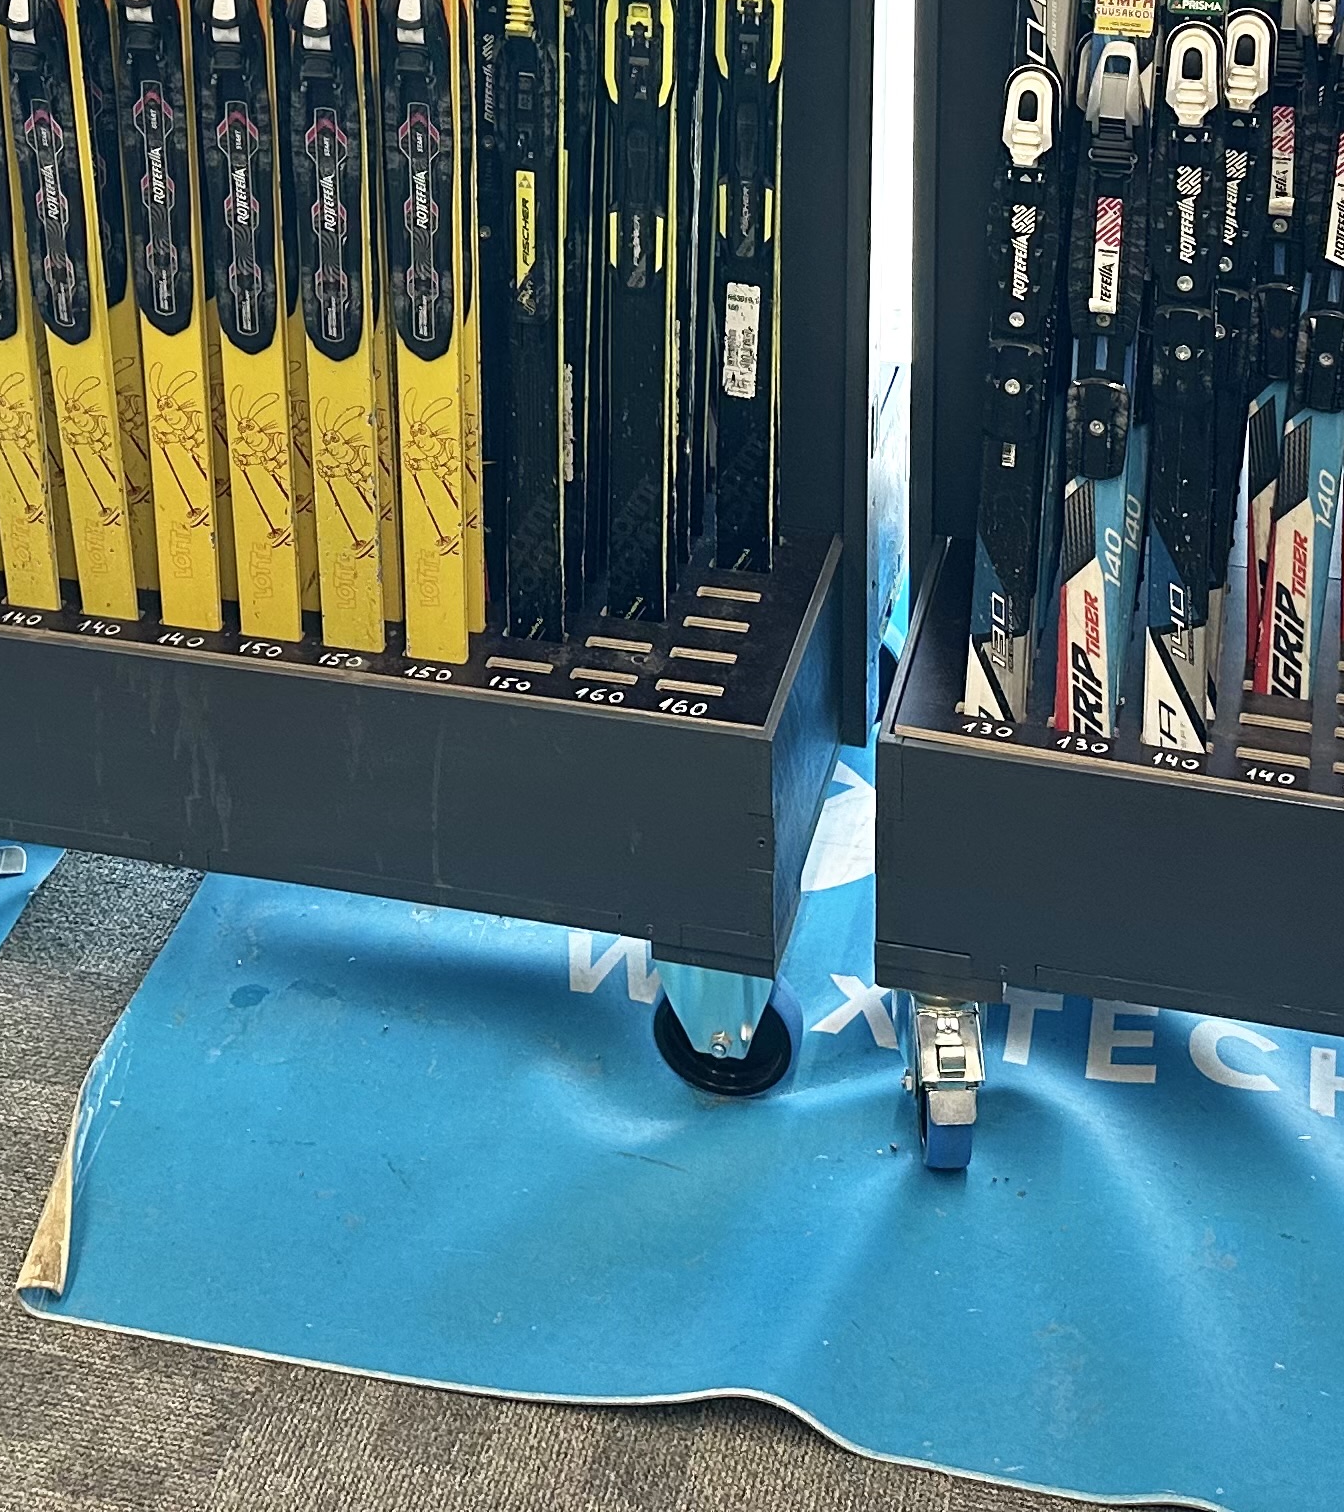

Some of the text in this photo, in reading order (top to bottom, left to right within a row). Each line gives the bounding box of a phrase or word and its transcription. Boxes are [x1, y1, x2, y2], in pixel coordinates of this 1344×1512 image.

[520, 196, 532, 268] FISCHER
[1, 610, 42, 627] 140
[77, 619, 121, 637] 140
[157, 631, 205, 650] 140
[239, 641, 284, 658] 150
[319, 652, 363, 669] 150
[404, 664, 452, 682] 150
[488, 675, 532, 693] 150
[575, 686, 626, 705] 160
[659, 697, 708, 717] 160
[962, 719, 1014, 739] 130
[1057, 734, 1110, 755] 130
[1152, 751, 1201, 772] 140
[1246, 767, 1296, 786] 140
